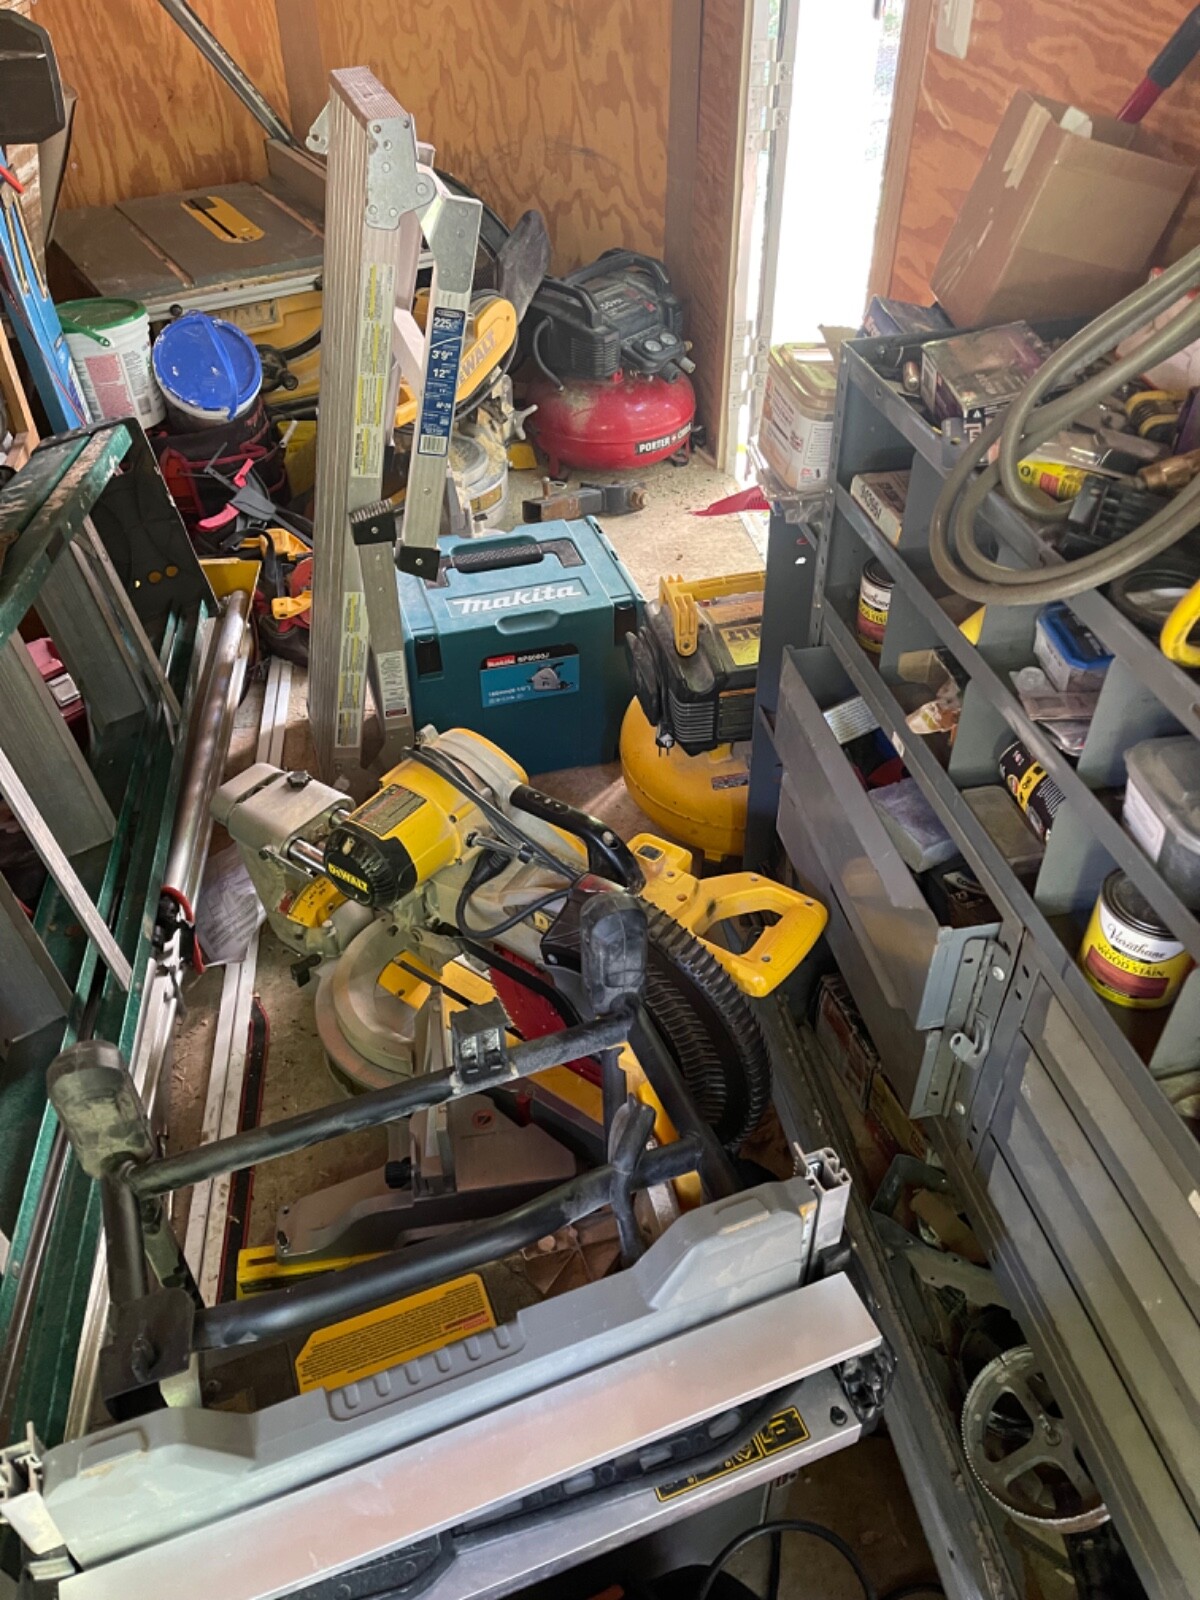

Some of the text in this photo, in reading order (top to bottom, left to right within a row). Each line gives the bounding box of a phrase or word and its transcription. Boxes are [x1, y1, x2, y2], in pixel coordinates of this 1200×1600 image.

[433, 316, 452, 330] 225
[458, 329, 498, 383] EWALT
[638, 435, 671, 454] PORTER
[452, 585, 582, 615] makita
[1107, 922, 1166, 958] Varathane
[1097, 943, 1166, 977] WOOD STAIN
